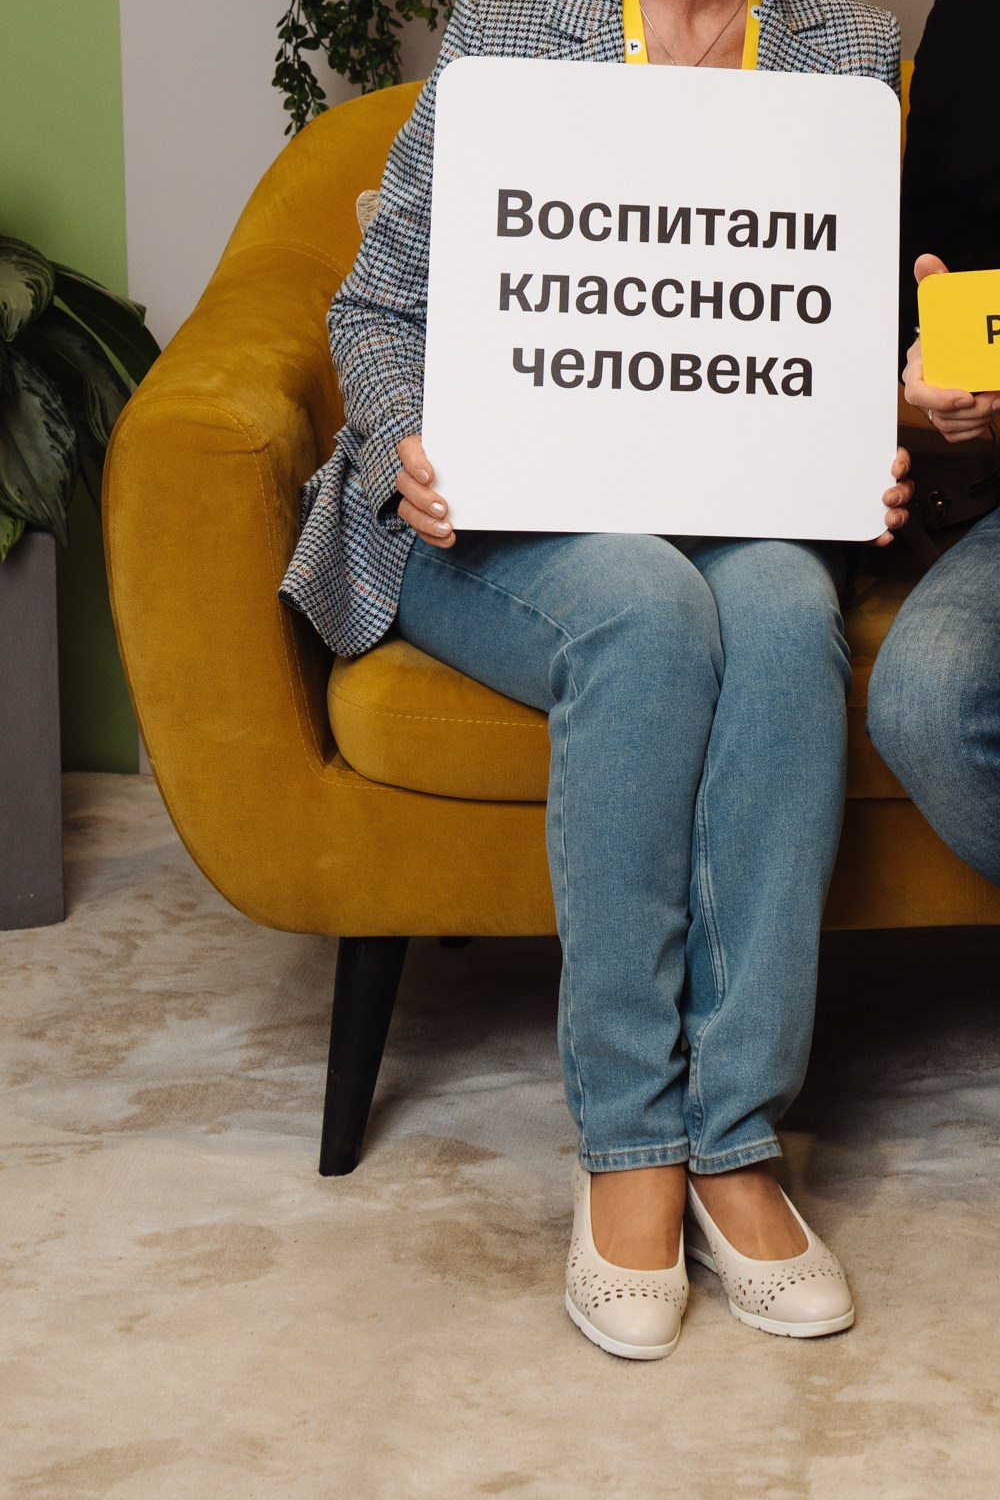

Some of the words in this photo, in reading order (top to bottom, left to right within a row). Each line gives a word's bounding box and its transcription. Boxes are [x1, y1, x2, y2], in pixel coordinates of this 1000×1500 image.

[496, 188, 837, 252] Воспитали
[499, 272, 832, 325] классного
[512, 347, 813, 397] человека
